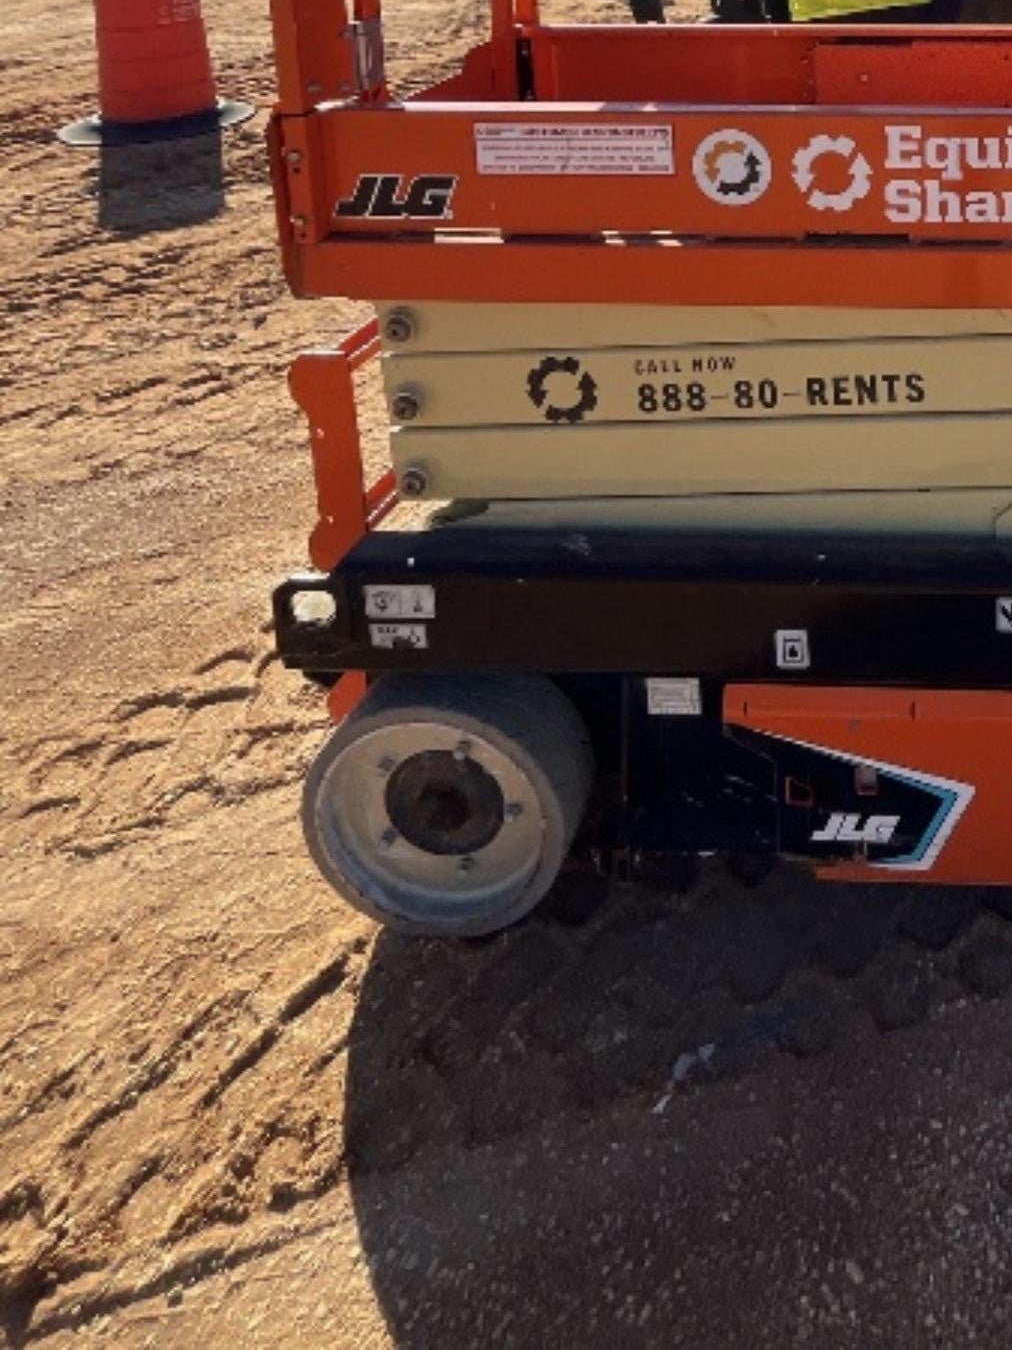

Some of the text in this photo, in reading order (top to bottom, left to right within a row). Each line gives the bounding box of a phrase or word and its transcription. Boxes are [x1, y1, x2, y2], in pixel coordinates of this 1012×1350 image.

[333, 173, 458, 219] JLG
[634, 356, 736, 376] CALL NOW
[810, 812, 902, 843] JLG
